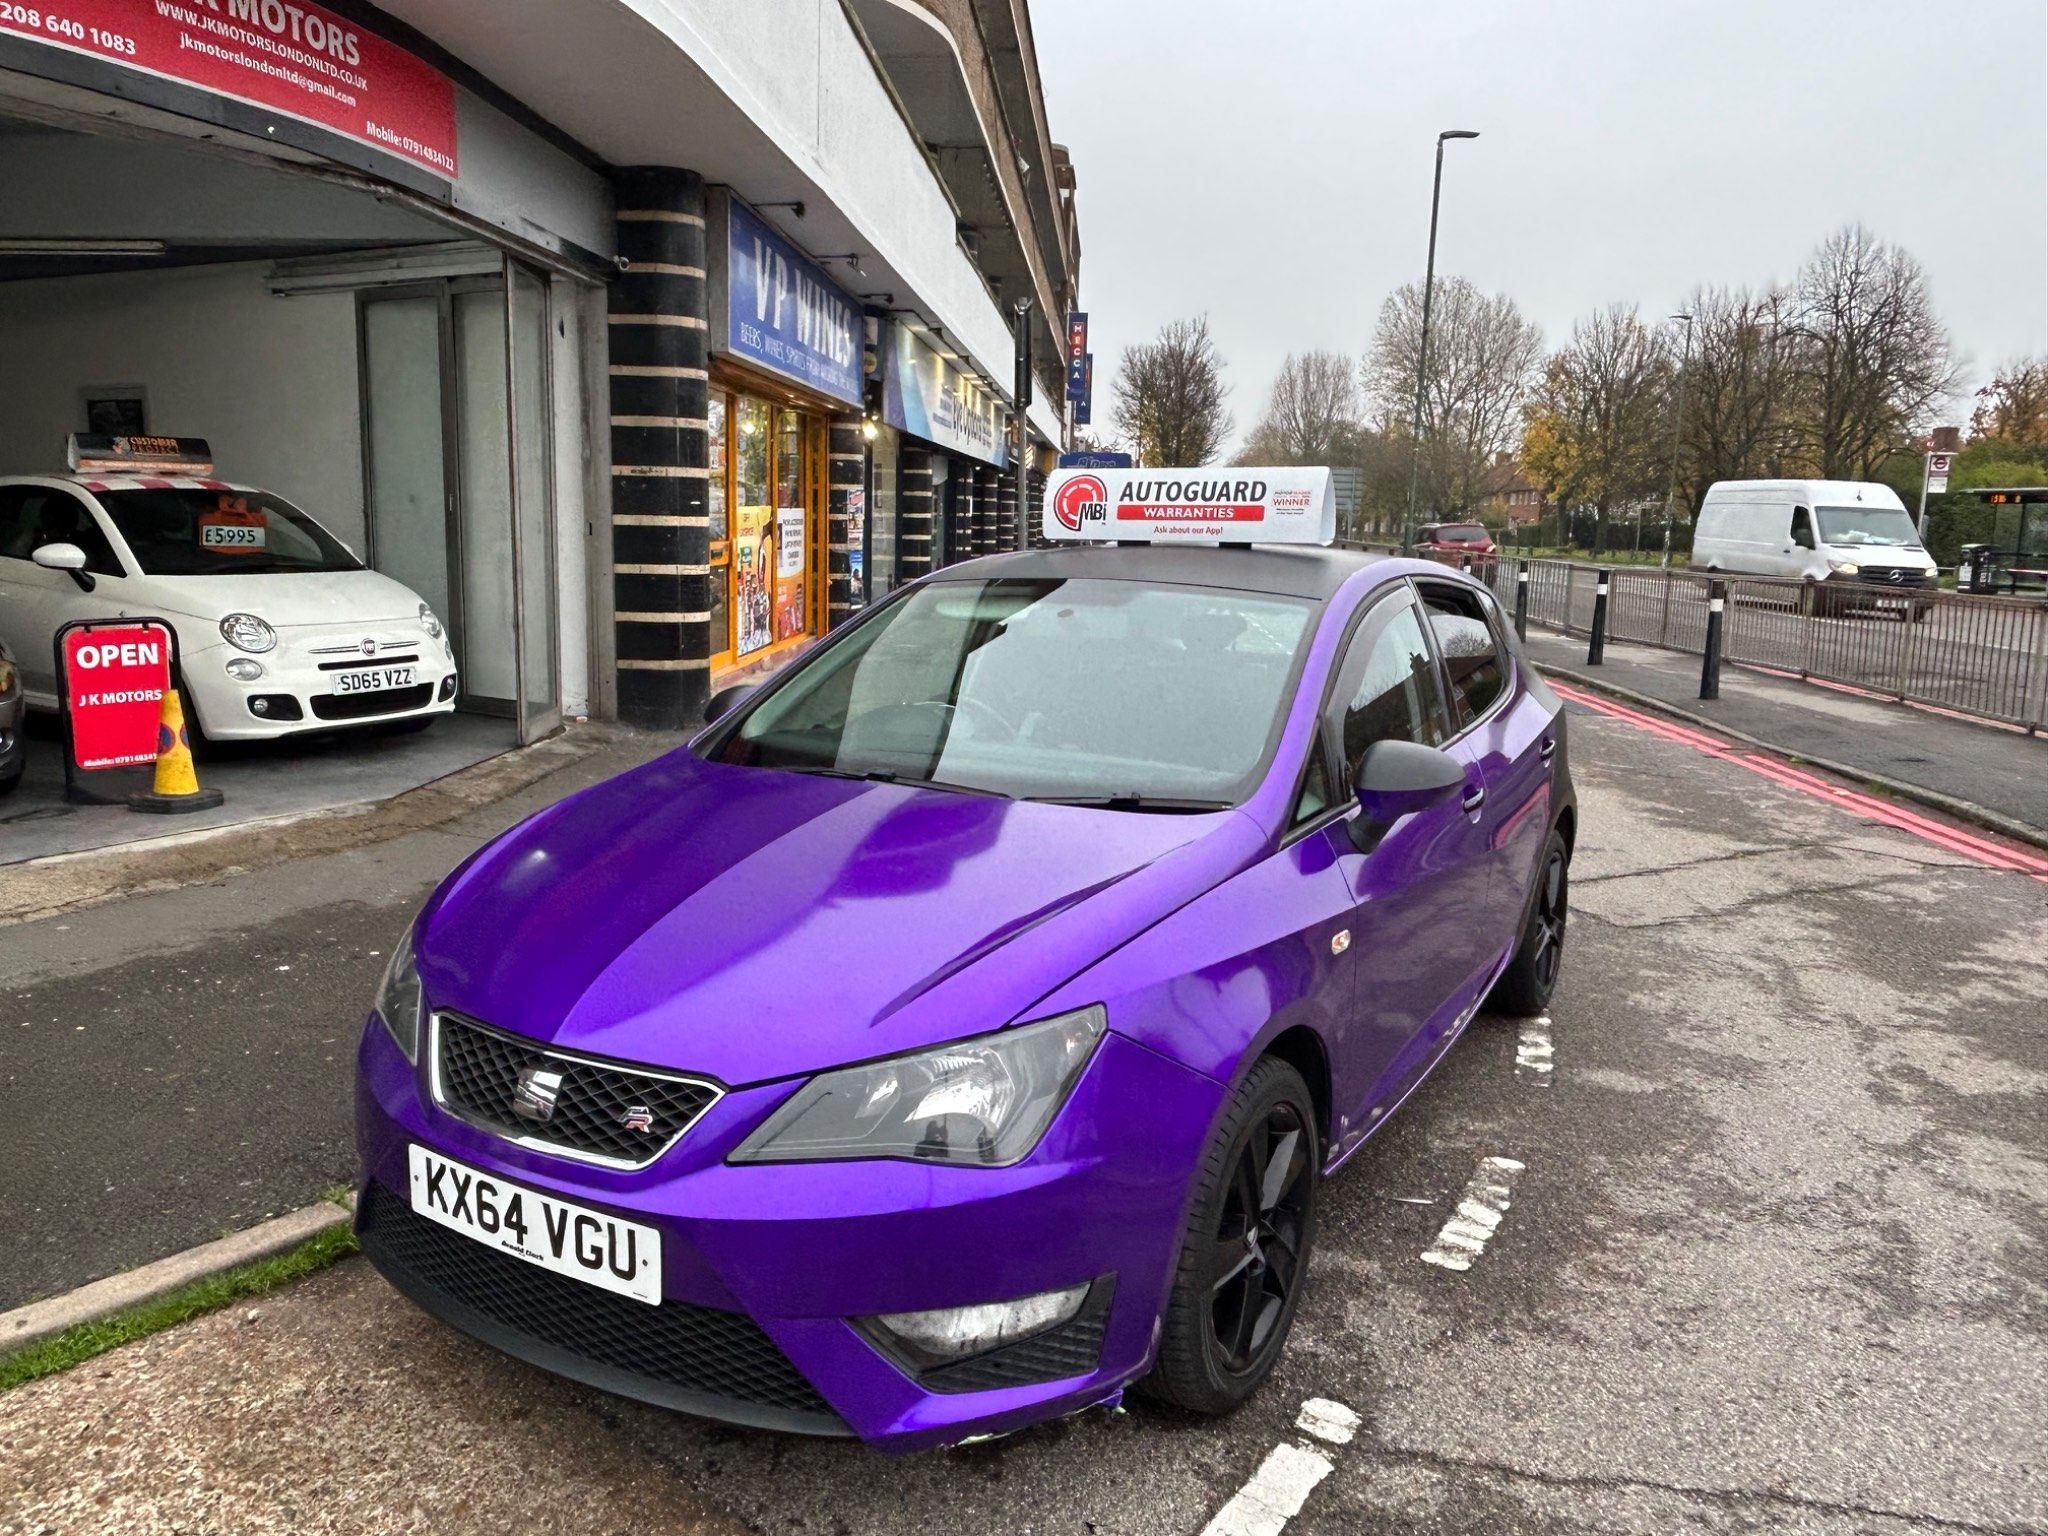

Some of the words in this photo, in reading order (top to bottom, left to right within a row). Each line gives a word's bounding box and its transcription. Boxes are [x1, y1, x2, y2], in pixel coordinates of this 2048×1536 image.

[45, 14, 85, 40] 640
[89, 27, 137, 55] 1083
[229, 0, 361, 66] MOTORS
[180, 31, 356, 107] jkmotorslondonltd@gmail.com
[366, 120, 402, 147] Mobile:
[754, 236, 788, 330] VP
[795, 268, 851, 368] WINES
[1073, 325, 1082, 379] MECCA
[1119, 481, 1267, 502] AUTOGUARD
[1272, 498, 1311, 506] WINNER
[1143, 507, 1235, 518] WARRANTIES
[205, 528, 256, 543] £5995
[1153, 526, 1167, 534] Ask
[1169, 526, 1190, 534] about
[1205, 526, 1223, 535] App!
[76, 642, 159, 669] OPEN
[340, 672, 381, 691] SD65
[384, 669, 412, 687] VZZ
[79, 694, 87, 707] J
[88, 693, 100, 706] K
[102, 689, 163, 704] MOTORS
[83, 756, 115, 767] Mobile:
[425, 1156, 528, 1245] KX64
[540, 1201, 636, 1281] VGU
